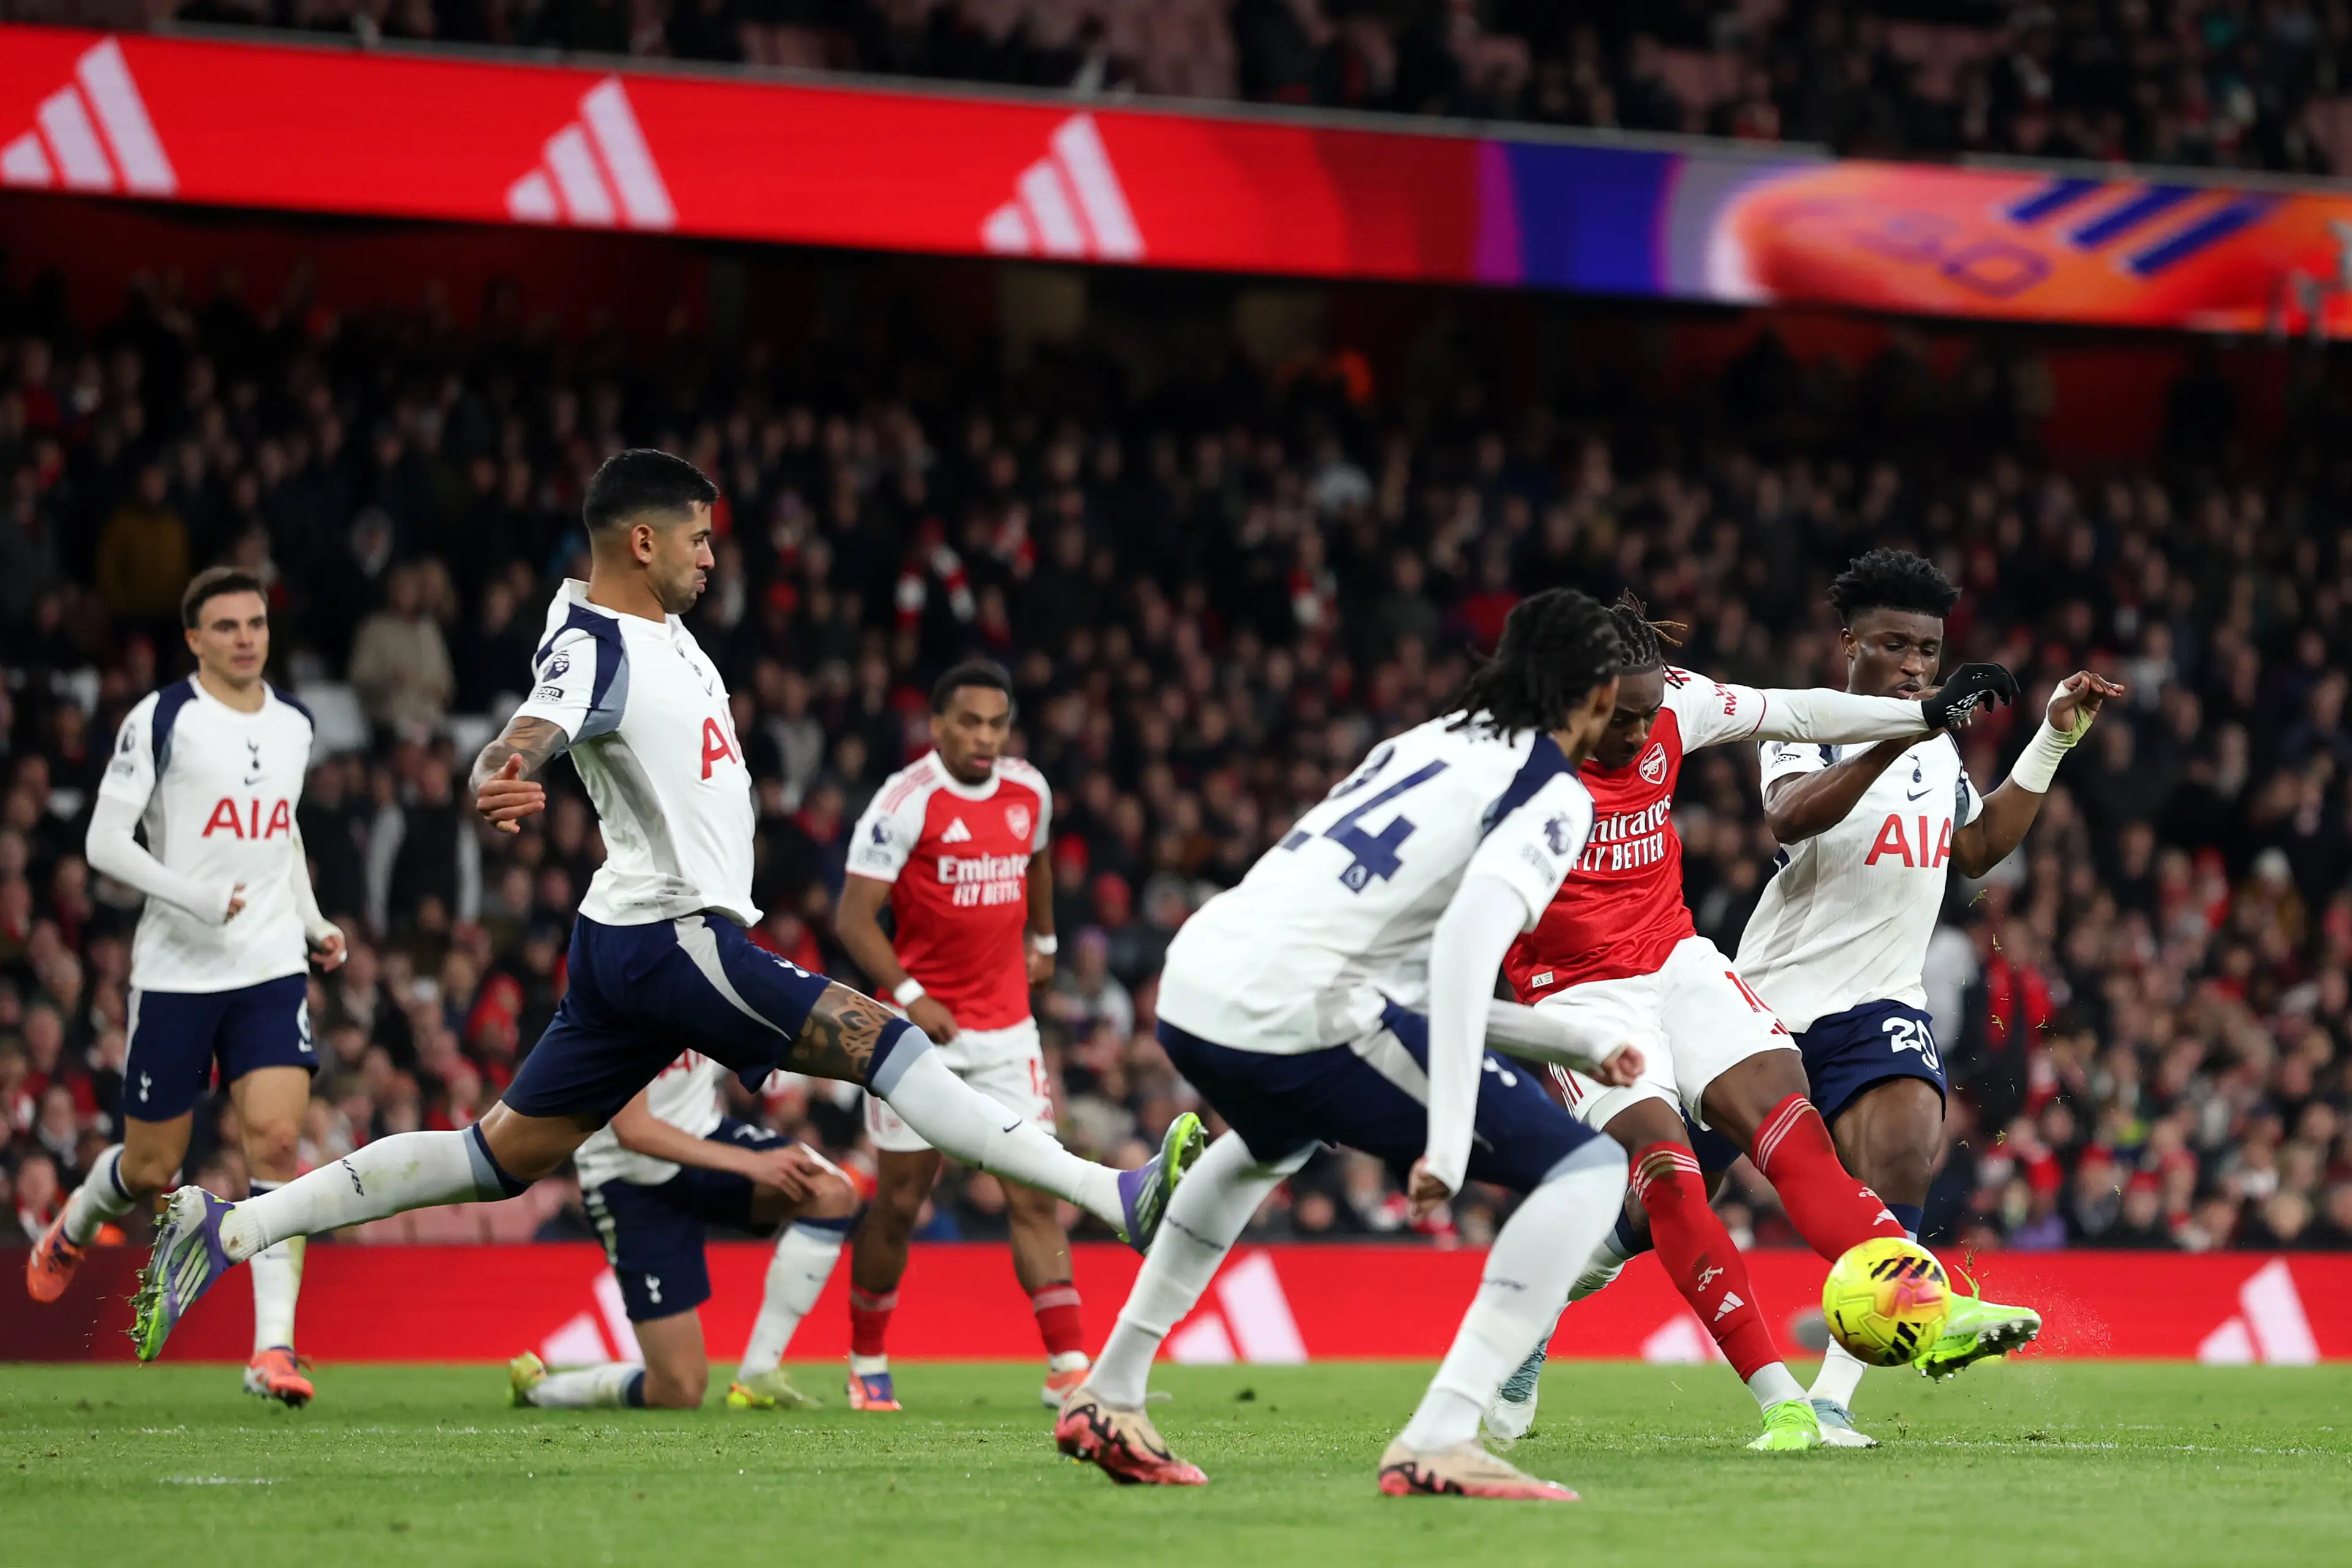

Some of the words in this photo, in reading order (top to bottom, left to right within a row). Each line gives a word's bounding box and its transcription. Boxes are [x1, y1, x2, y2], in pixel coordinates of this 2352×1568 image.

[202, 797, 290, 840] AIA
[1588, 794, 1672, 843] mirates
[1864, 813, 1951, 869] AIA
[1611, 831, 1665, 872] BETTER
[1882, 1017, 1939, 1071] 20
